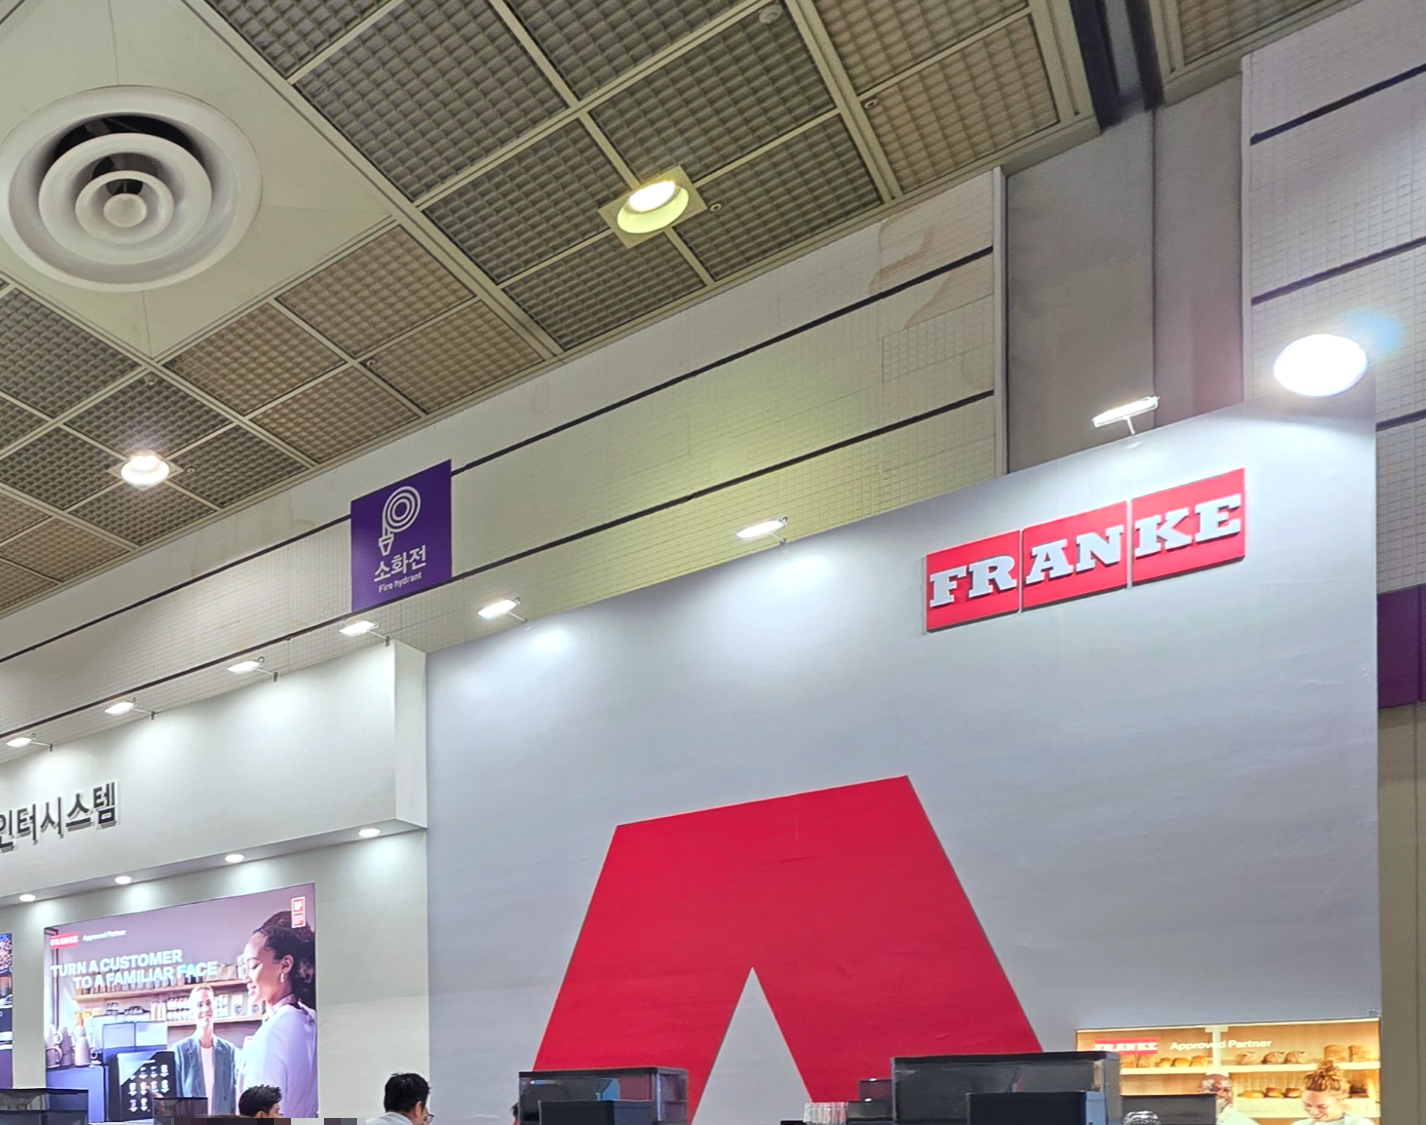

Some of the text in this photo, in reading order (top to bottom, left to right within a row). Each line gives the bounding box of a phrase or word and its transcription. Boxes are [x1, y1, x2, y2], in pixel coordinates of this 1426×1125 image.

[373, 545, 426, 583] 소화전
[929, 493, 1241, 608] FRANKE
[378, 572, 422, 593] Fire hydrant
[82, 931, 107, 942] Approved
[107, 930, 127, 939] Partner
[50, 949, 183, 978] TURN A CUSTOMER
[73, 961, 218, 989] TO A FAMILIAR FACE
[1094, 1039, 1273, 1052] FRANKE Approved Partner
